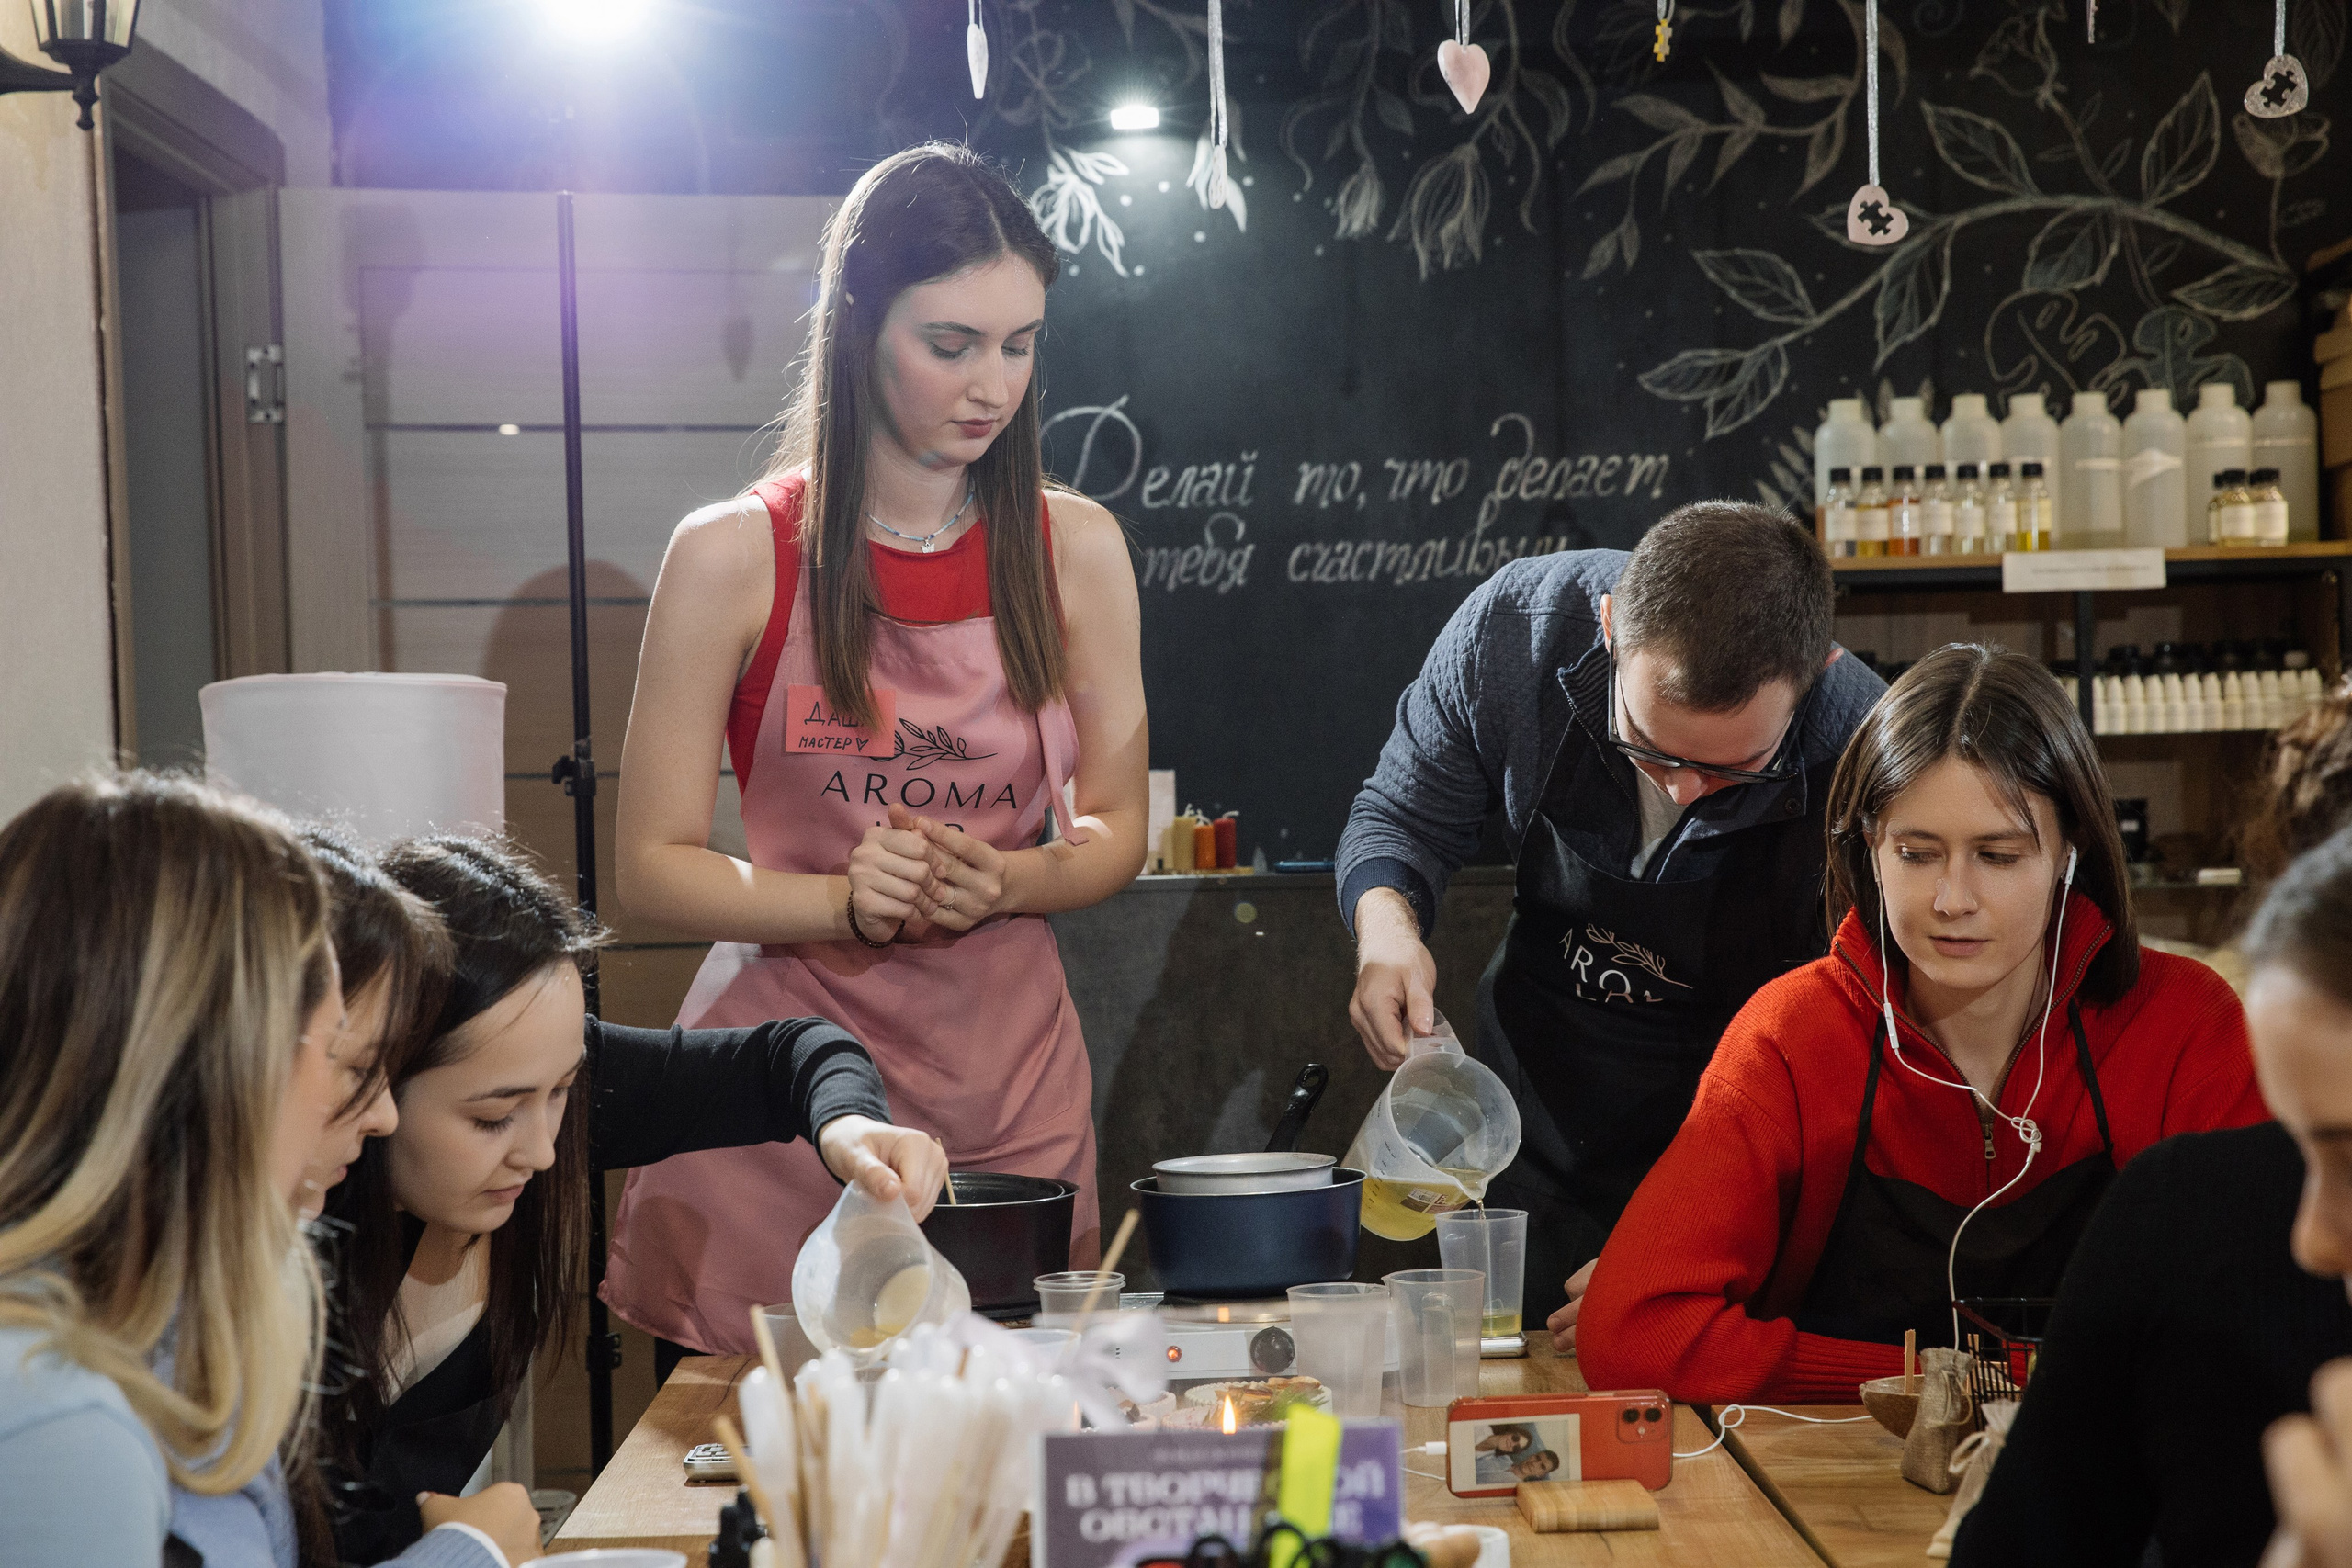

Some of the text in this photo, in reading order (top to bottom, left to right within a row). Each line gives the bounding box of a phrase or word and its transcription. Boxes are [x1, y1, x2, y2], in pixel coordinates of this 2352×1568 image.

[1040, 394, 1670, 510] Делай то, что делает
[1143, 512, 1257, 594] тебя
[804, 701, 864, 728] ДАШ
[798, 736, 853, 750] МАСТЕР
[820, 770, 1017, 809] AROMA
